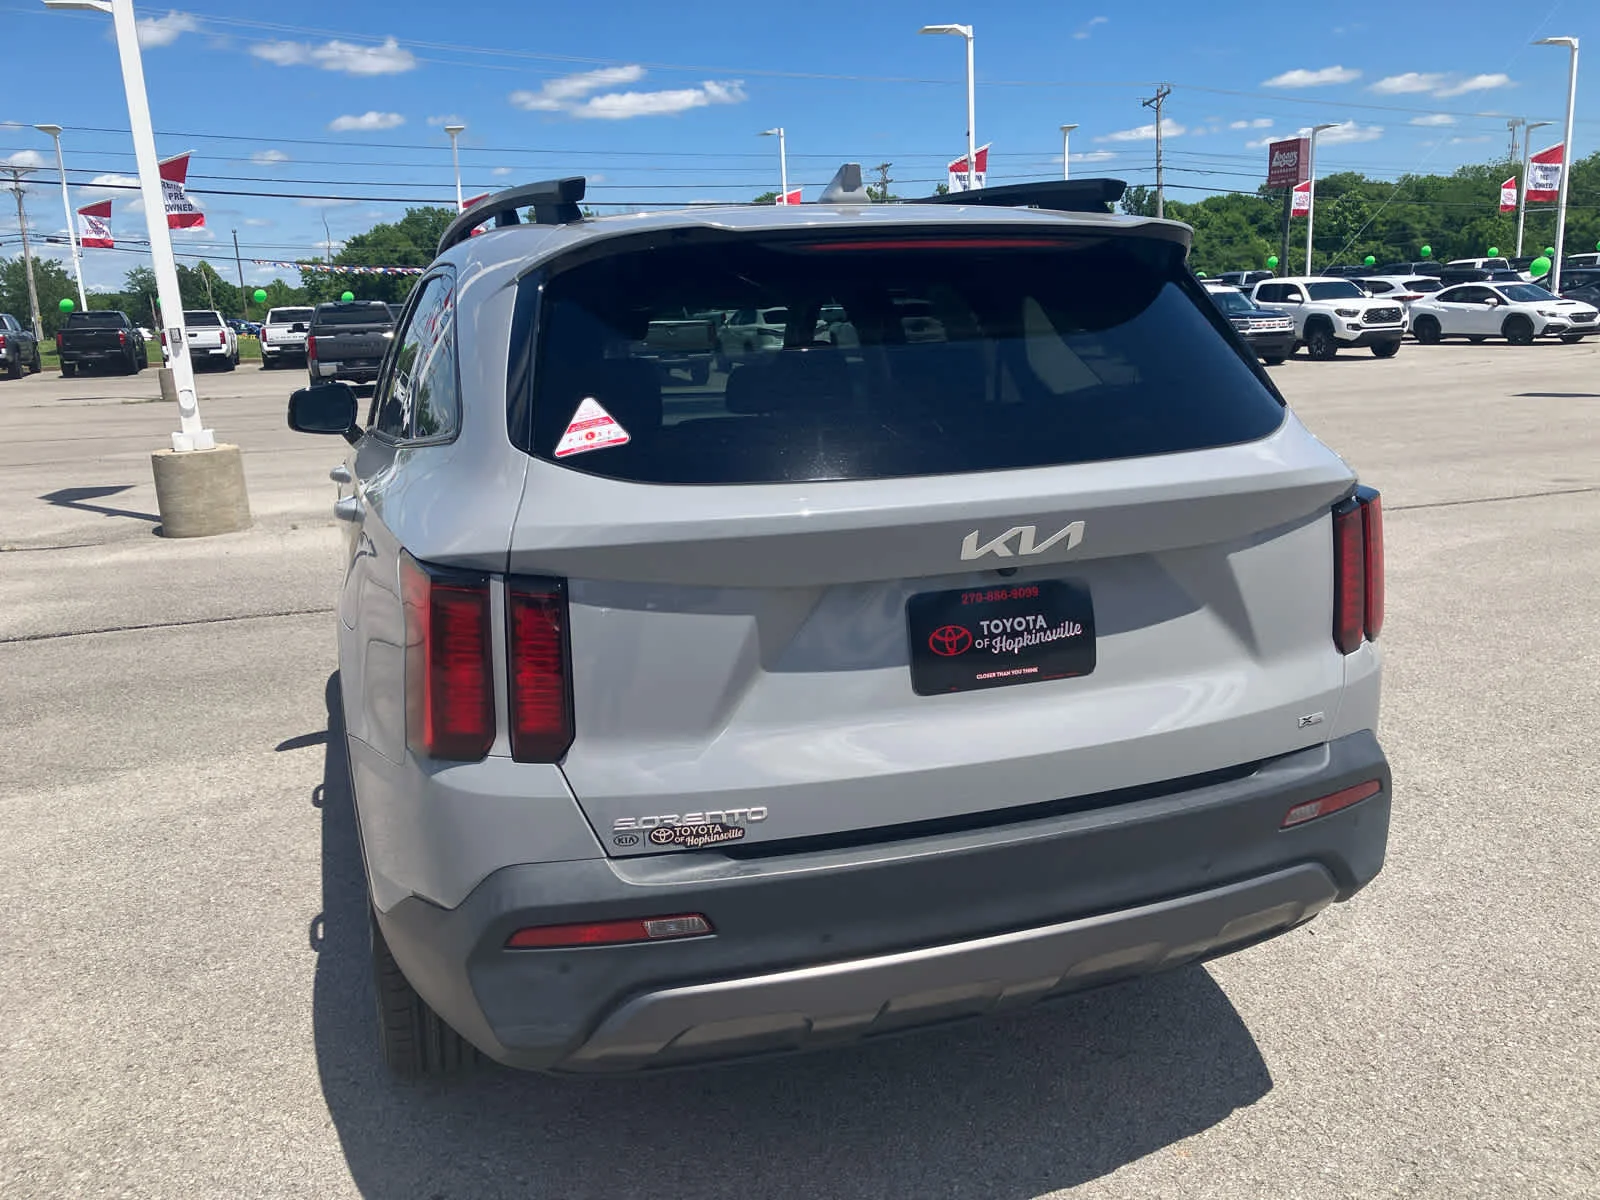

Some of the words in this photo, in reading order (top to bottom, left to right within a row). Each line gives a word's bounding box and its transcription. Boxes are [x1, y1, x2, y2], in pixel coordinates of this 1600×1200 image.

[168, 192, 185, 201] PRE
[165, 203, 193, 212] OWNED
[960, 520, 1086, 561] KIA
[979, 614, 1048, 636] TOYOTA
[975, 638, 991, 649] OF
[991, 620, 1083, 654] Hopkinsville
[976, 671, 996, 680] CLOSER
[996, 669, 1011, 678] THAN
[1011, 668, 1022, 676] YOU
[1022, 666, 1039, 674] THINK
[612, 806, 768, 831] SORENTO
[674, 824, 723, 836] TOYOTA
[674, 836, 685, 844] OF
[685, 827, 745, 848] Hopkinsville
